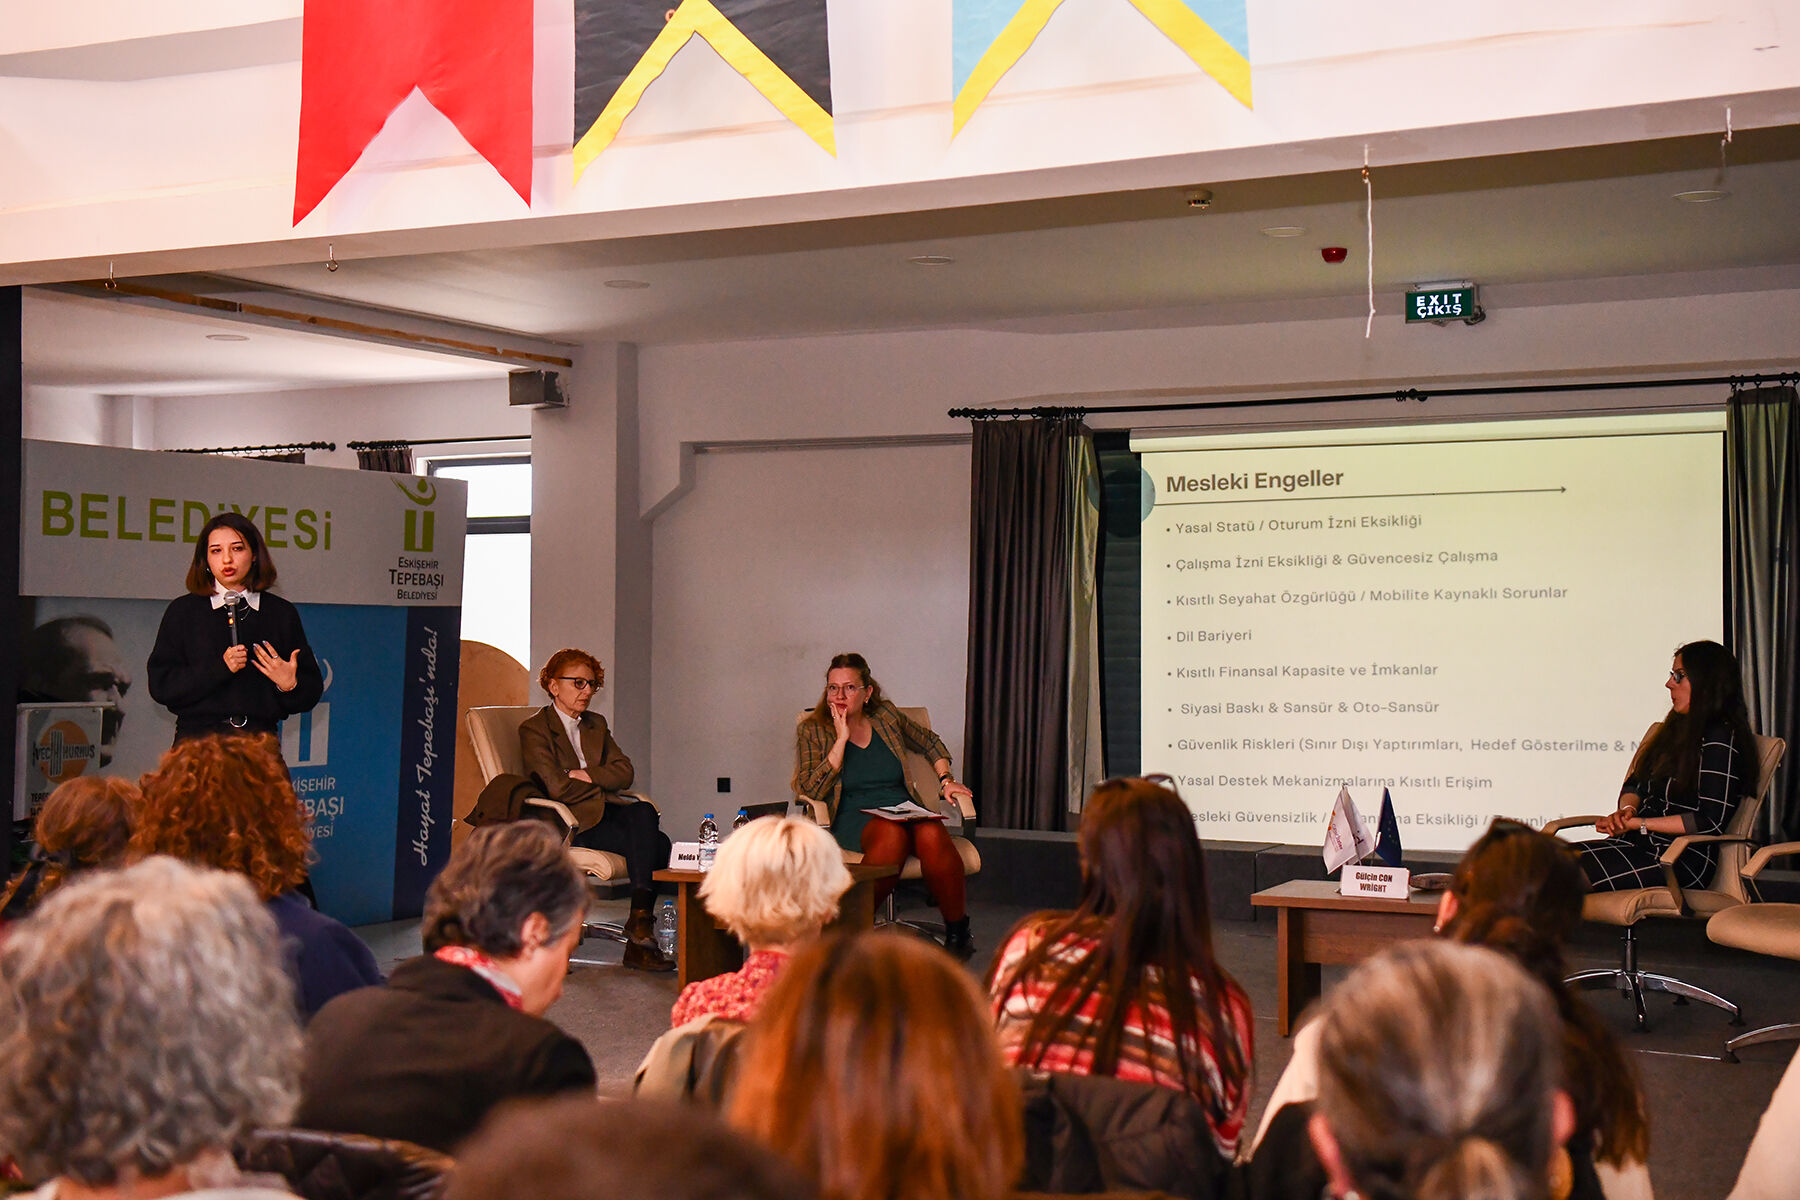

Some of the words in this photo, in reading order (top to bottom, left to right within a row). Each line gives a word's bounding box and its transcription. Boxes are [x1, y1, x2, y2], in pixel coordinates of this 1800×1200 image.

[1416, 293, 1462, 307] EXIT
[1416, 303, 1462, 319] ÇIKIŞ
[1166, 472, 1249, 493] Mesleki
[1254, 469, 1344, 493] Engeller
[1175, 521, 1212, 534] Yasal
[1216, 520, 1255, 533] Statü
[1258, 519, 1265, 532] /
[1268, 519, 1323, 531] Oturum
[1327, 515, 1356, 529] İzni
[1360, 514, 1422, 529] Eksikliği
[1175, 558, 1231, 573] Çalışma
[1235, 554, 1264, 569] İzni
[1267, 554, 1328, 569] Eksikliği
[1331, 553, 1343, 566] &
[1346, 551, 1433, 566] Güvencesiz
[1438, 551, 1498, 566] Çalışma
[389, 569, 444, 589] TEPEBAŞI
[1176, 593, 1215, 606] Kısıtlı
[1218, 592, 1276, 607] Seyahat
[1280, 590, 1356, 606] Özgürlüğü
[1359, 590, 1366, 602] /
[1369, 589, 1430, 601] Mobilite
[1433, 587, 1498, 603] Kaynaklı
[1502, 586, 1568, 599] Sorunlar
[1176, 630, 1194, 643] Dil
[1197, 630, 1252, 644] Bariyeri
[1176, 666, 1215, 679] Kısıtlı
[1219, 665, 1278, 678] Finansal
[1282, 664, 1345, 679] Kapasite
[1349, 666, 1367, 676] ve
[1371, 662, 1439, 676] İmkanlar
[1180, 702, 1222, 717] Siyasi
[1226, 701, 1264, 714] Baskı
[1268, 702, 1279, 714] &
[1283, 701, 1333, 714] Sansür
[1337, 701, 1349, 713] &
[1177, 738, 1239, 751] Güvenlik
[1242, 737, 1295, 750] Riskleri
[1298, 737, 1337, 753] (Sınır
[1341, 738, 1369, 752] Dışı
[1470, 738, 1517, 751] Hedef
[1521, 738, 1609, 752] Gösterilme
[1613, 740, 1625, 752] &
[1177, 775, 1214, 787] Yasal
[1218, 774, 1269, 787] Destek
[1273, 775, 1395, 788] Mekanizmalarına
[1399, 776, 1441, 788] Kısıtlı
[1445, 776, 1493, 791] Erişim
[412, 789, 435, 866] Hayat
[1192, 810, 1231, 823] esleki
[1235, 811, 1318, 824] Güvensizlik
[1321, 811, 1328, 823] /
[1415, 813, 1478, 829] Eksikliği
[1482, 814, 1489, 826] /
